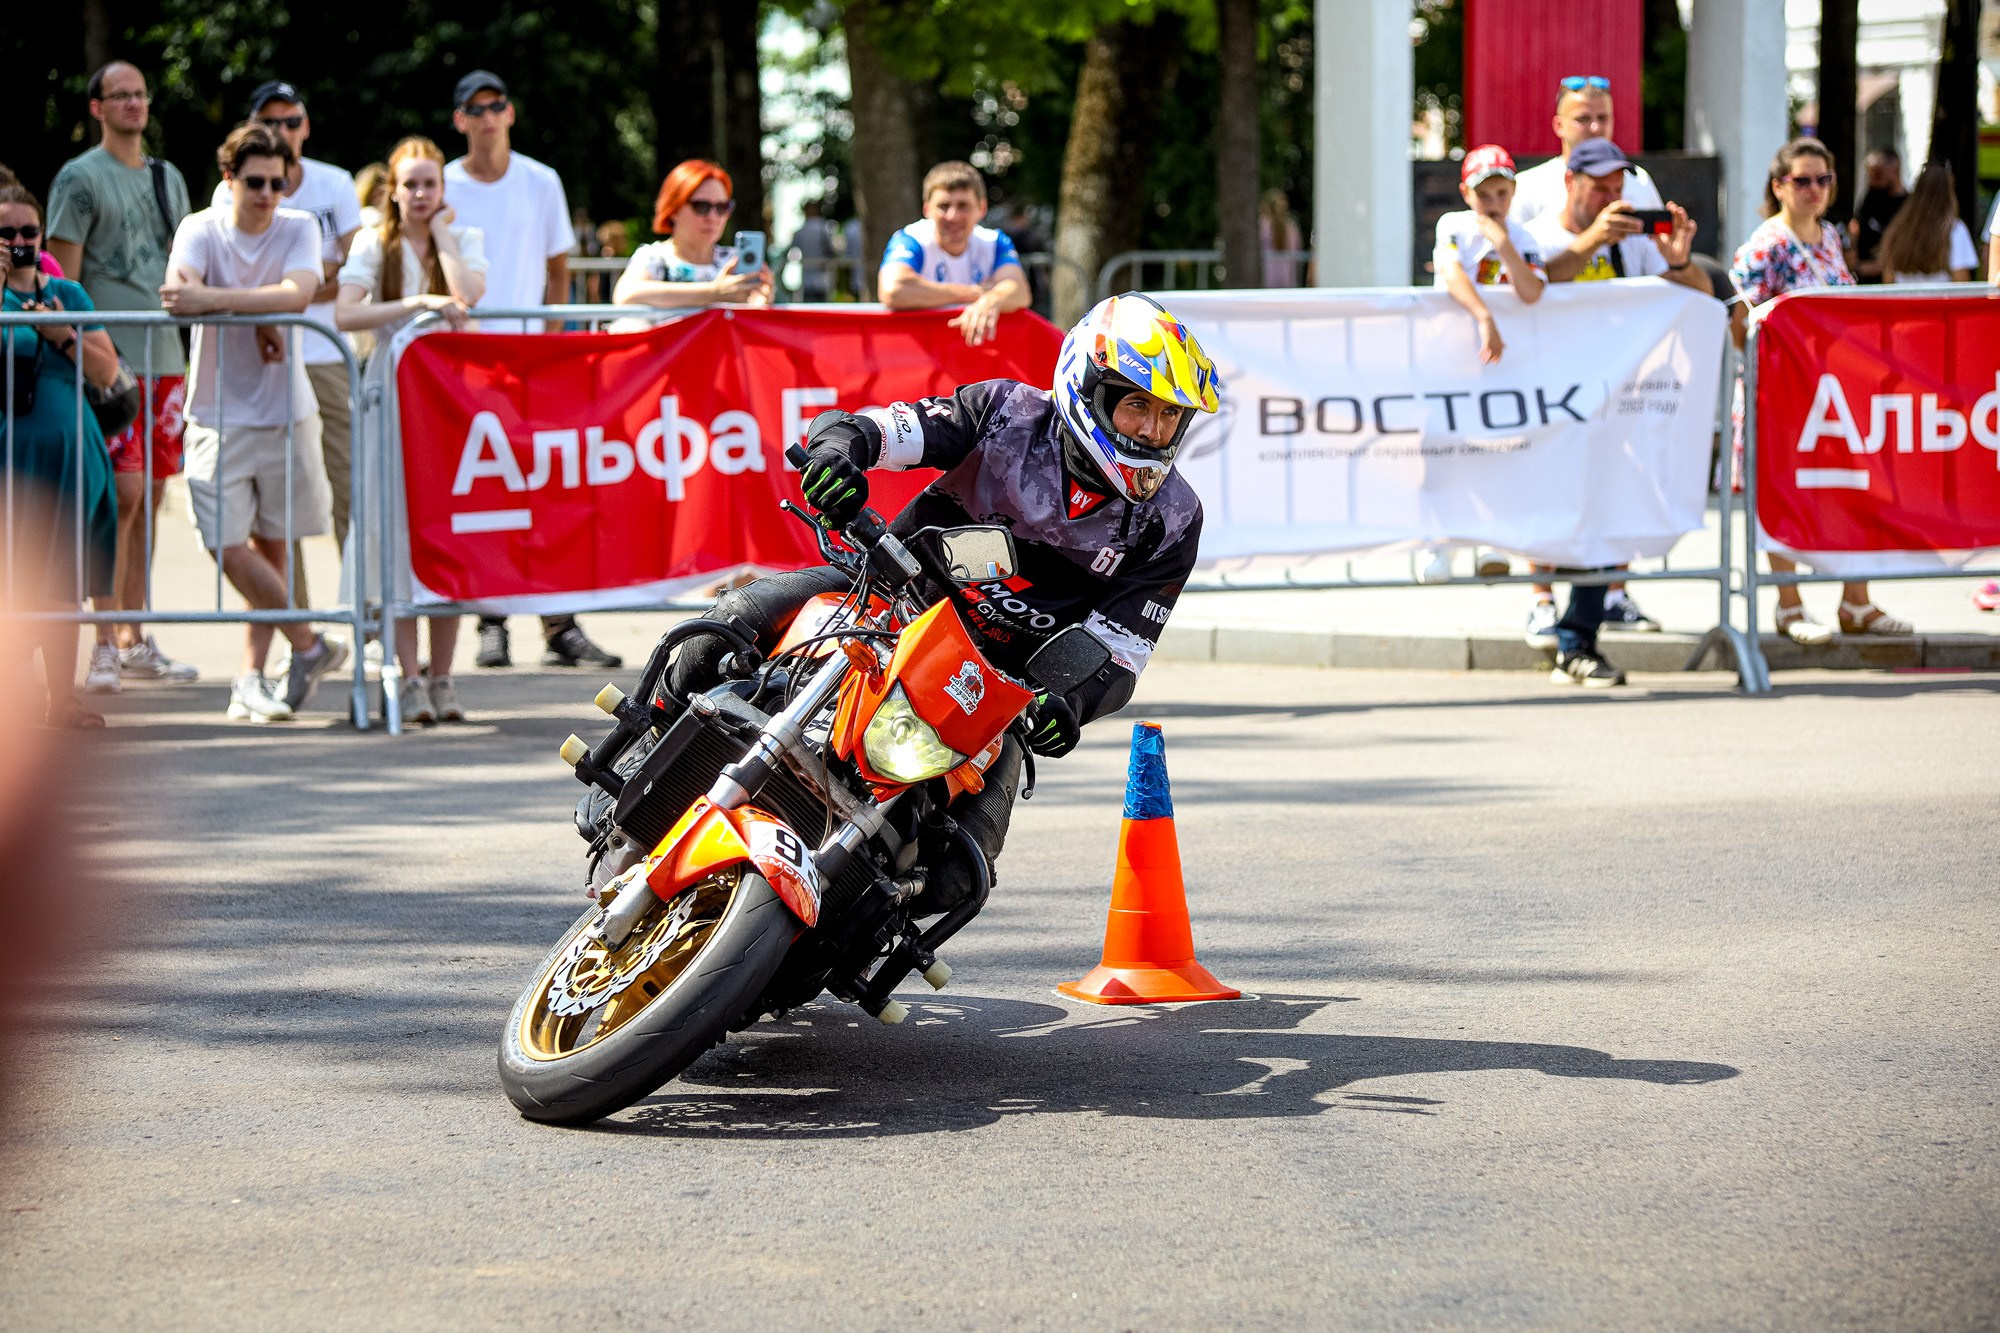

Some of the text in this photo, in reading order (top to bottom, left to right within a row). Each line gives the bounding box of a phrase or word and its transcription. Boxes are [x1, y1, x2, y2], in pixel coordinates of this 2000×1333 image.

[1118, 353, 1151, 375] UFO
[1259, 384, 1587, 436] ВОСТОК
[451, 395, 767, 501] Альфа
[1070, 489, 1093, 509] BY
[1090, 546, 1126, 577] 61
[980, 583, 1056, 629] MOTO
